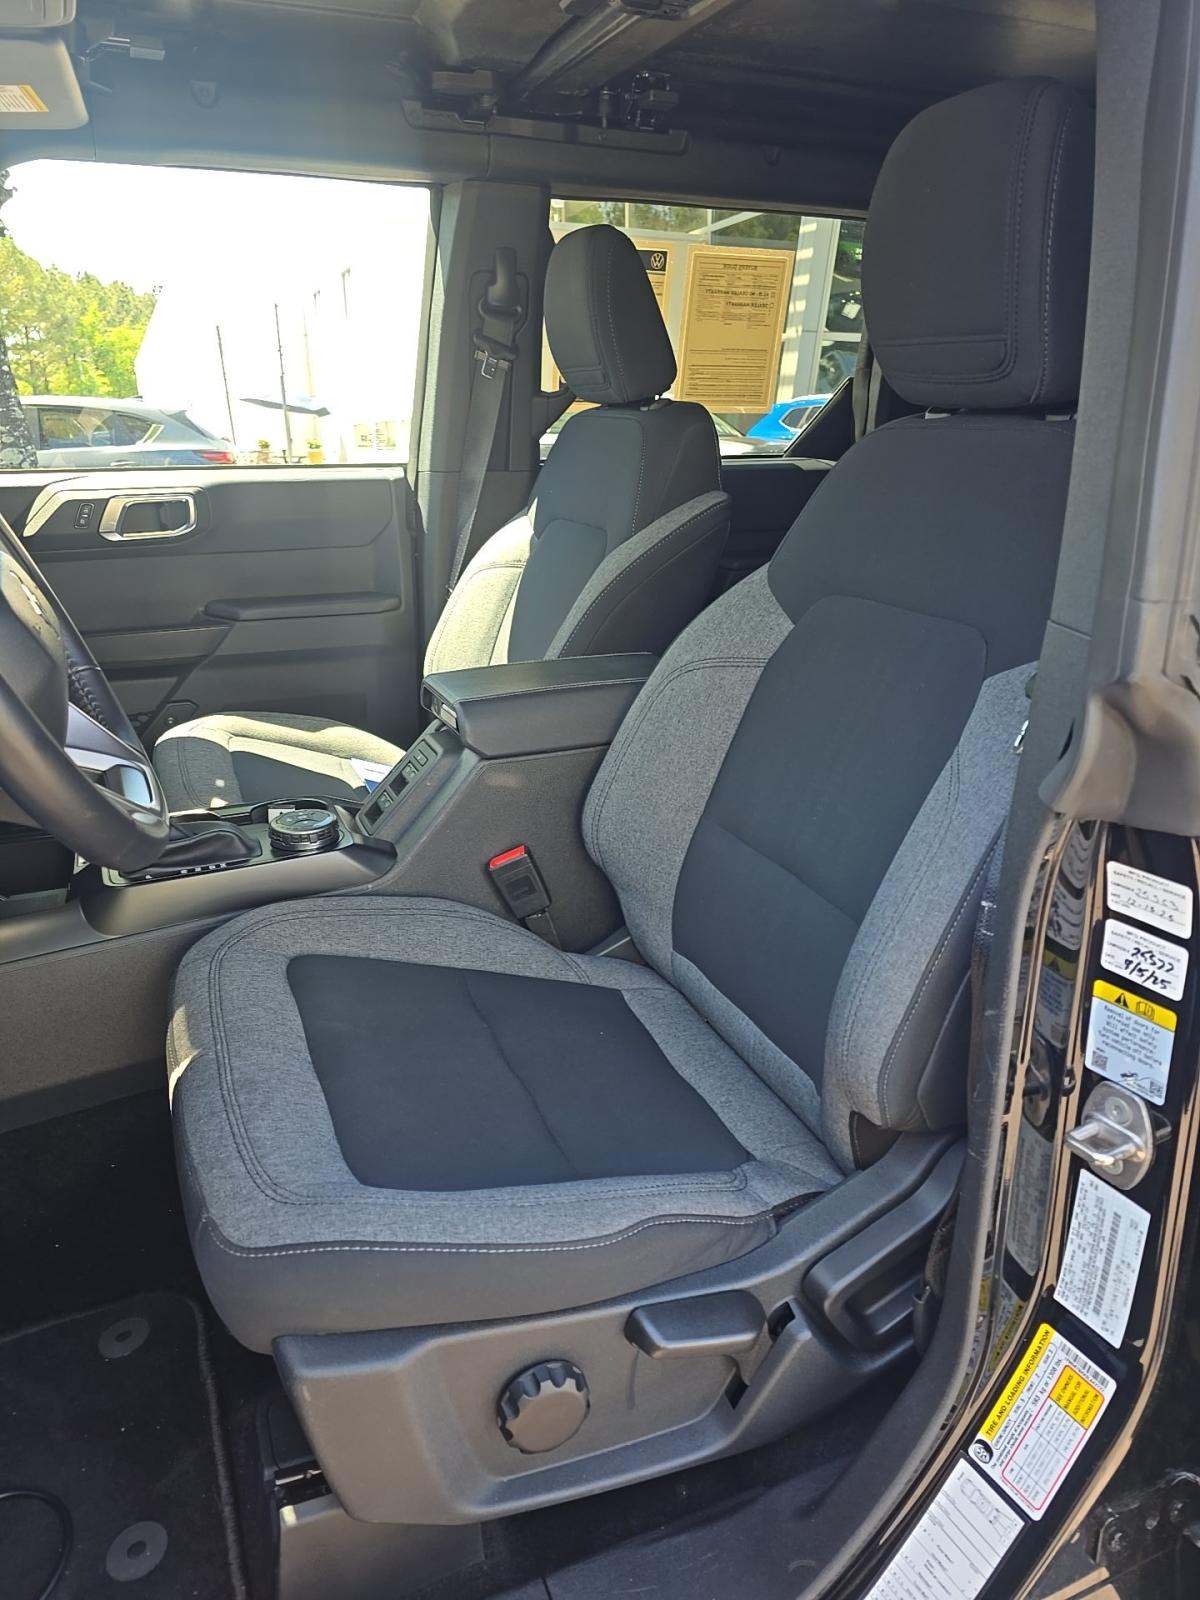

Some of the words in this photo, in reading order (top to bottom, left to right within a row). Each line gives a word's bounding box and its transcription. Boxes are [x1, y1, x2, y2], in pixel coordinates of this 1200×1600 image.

[985, 1418, 998, 1437] TIRE
[996, 1404, 1006, 1420] AND
[1004, 1374, 1025, 1405] LOADING
[1020, 1328, 1051, 1376] INFORMATION
